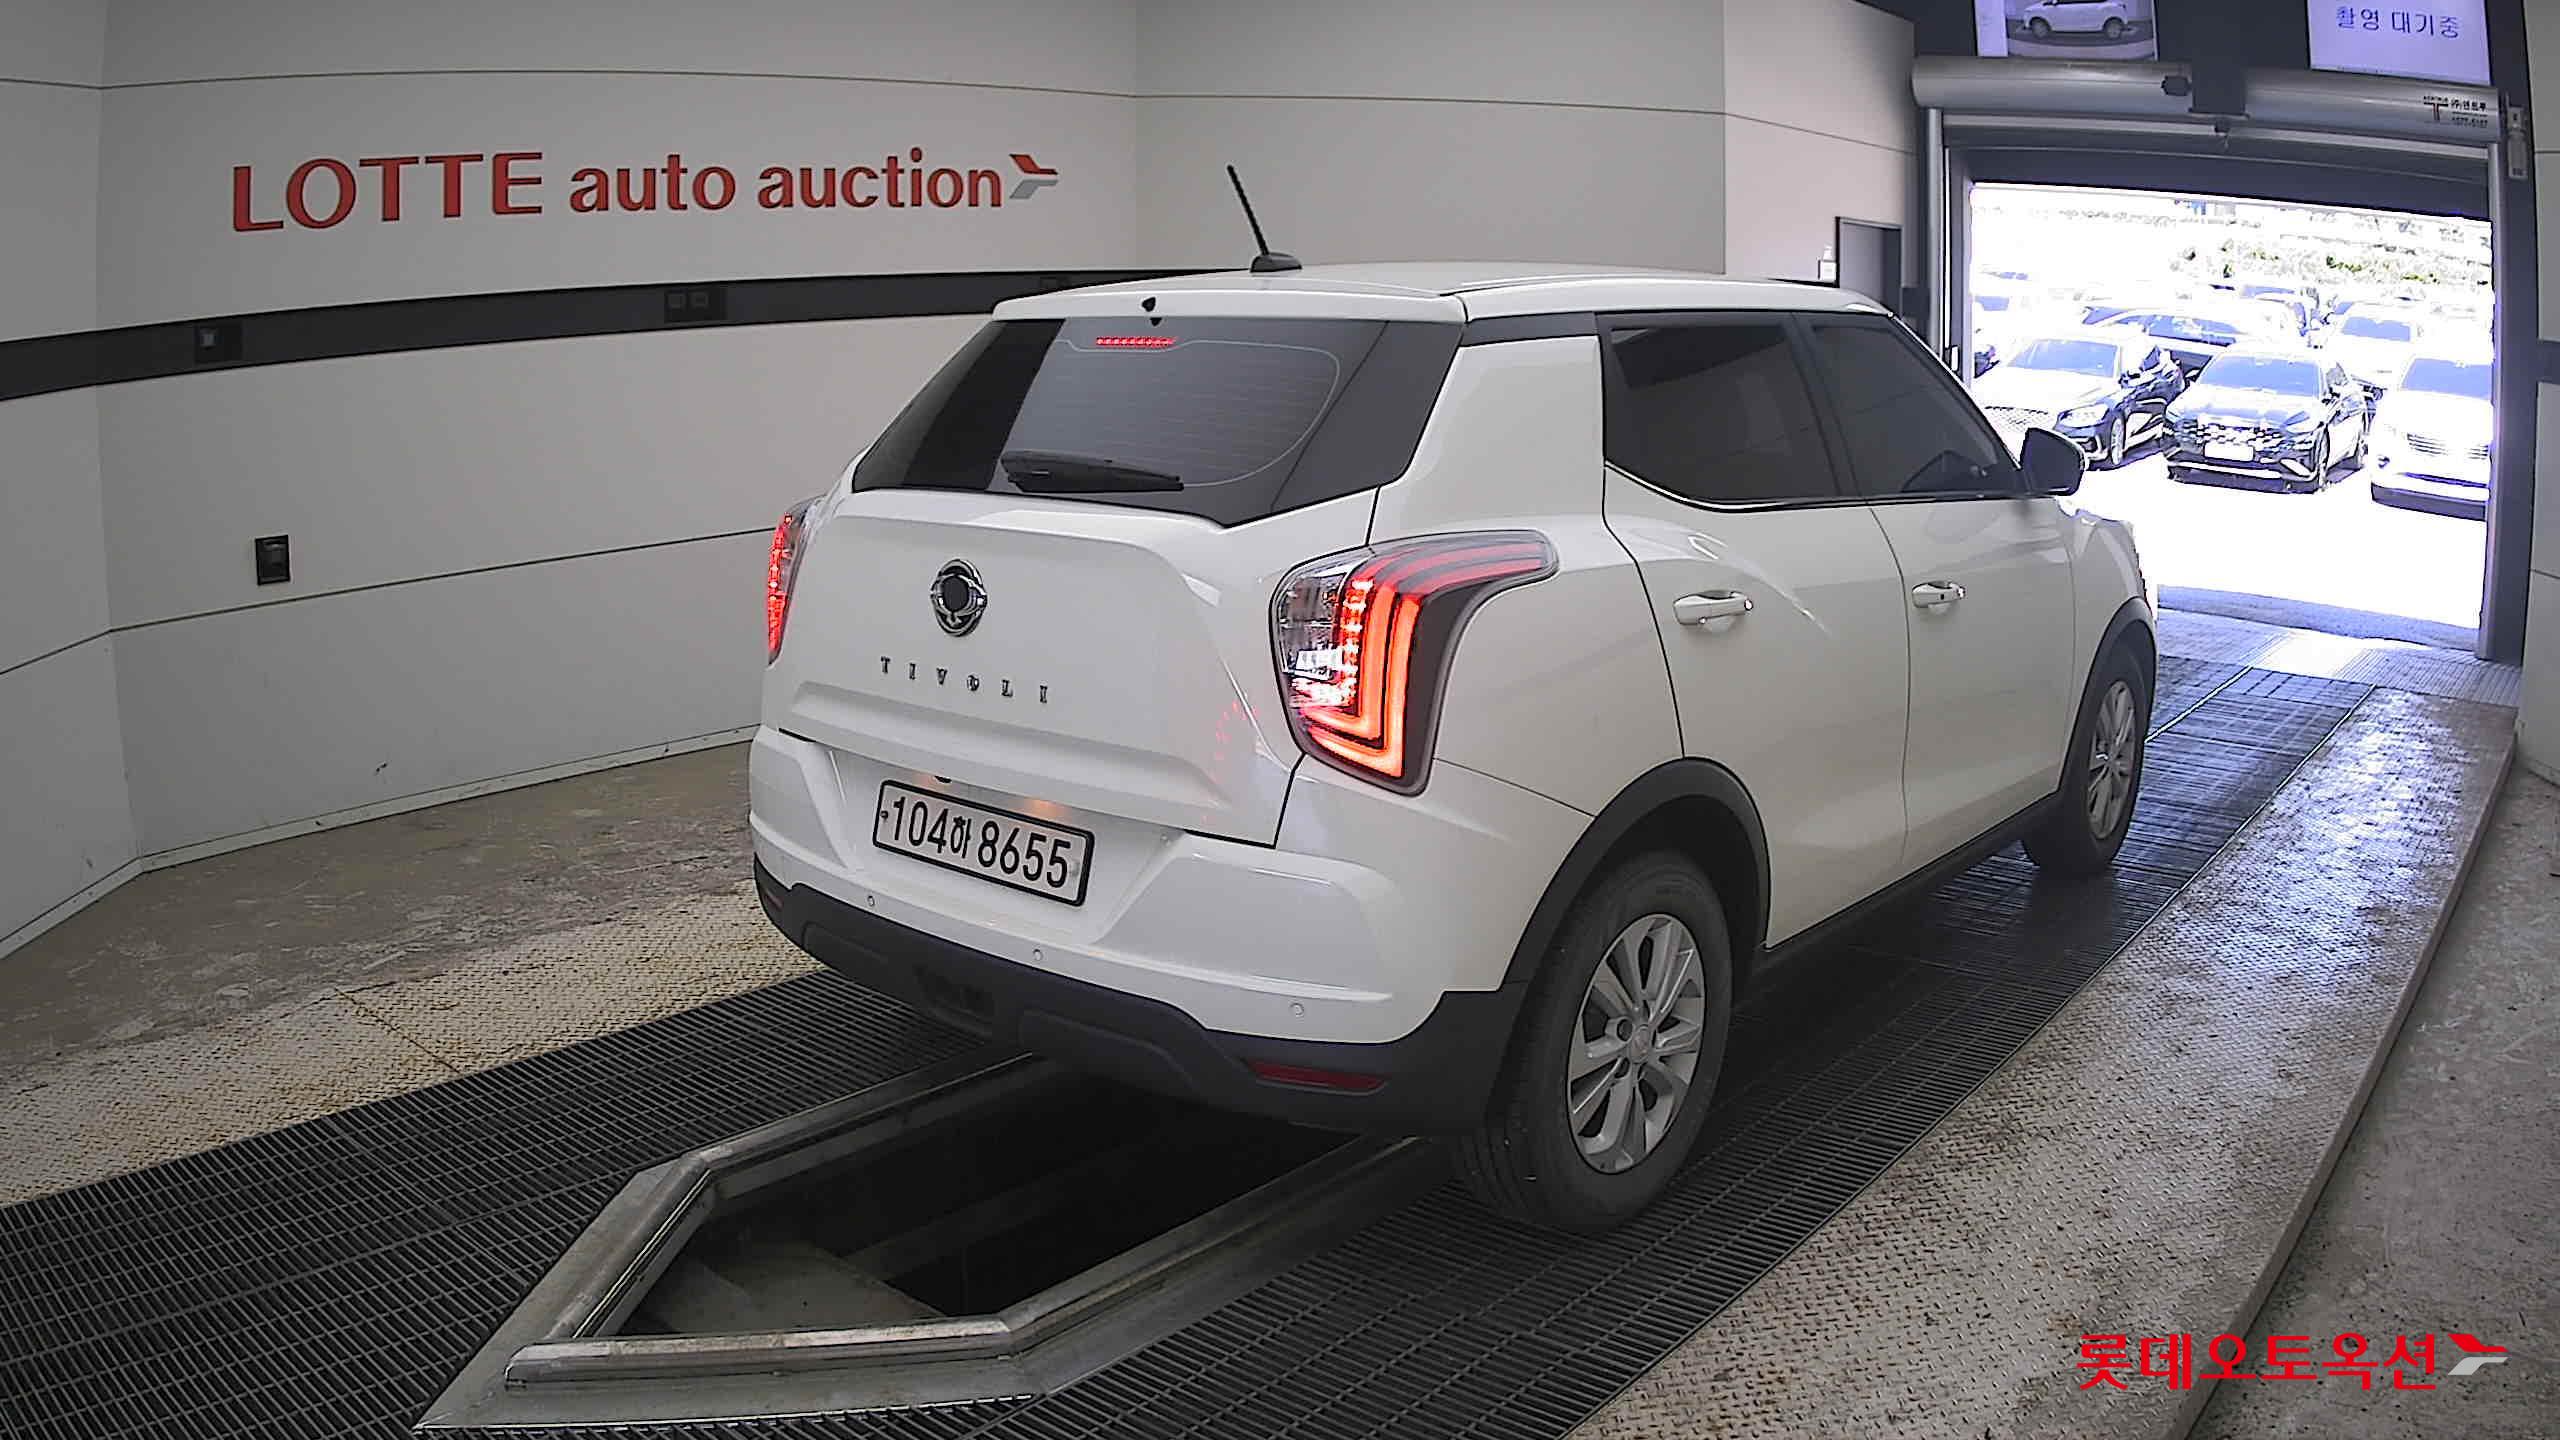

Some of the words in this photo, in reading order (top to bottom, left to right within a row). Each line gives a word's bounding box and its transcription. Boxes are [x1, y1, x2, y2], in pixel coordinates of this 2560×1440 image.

[2336, 6, 2380, 31] 촬영
[2391, 11, 2459, 39] 대기중
[233, 151, 543, 233] LOTTE
[569, 153, 738, 212] auto
[757, 146, 1003, 210] auction
[880, 655, 1049, 704] TIVOLI
[893, 796, 972, 859] 104하
[977, 820, 1072, 888] 8655
